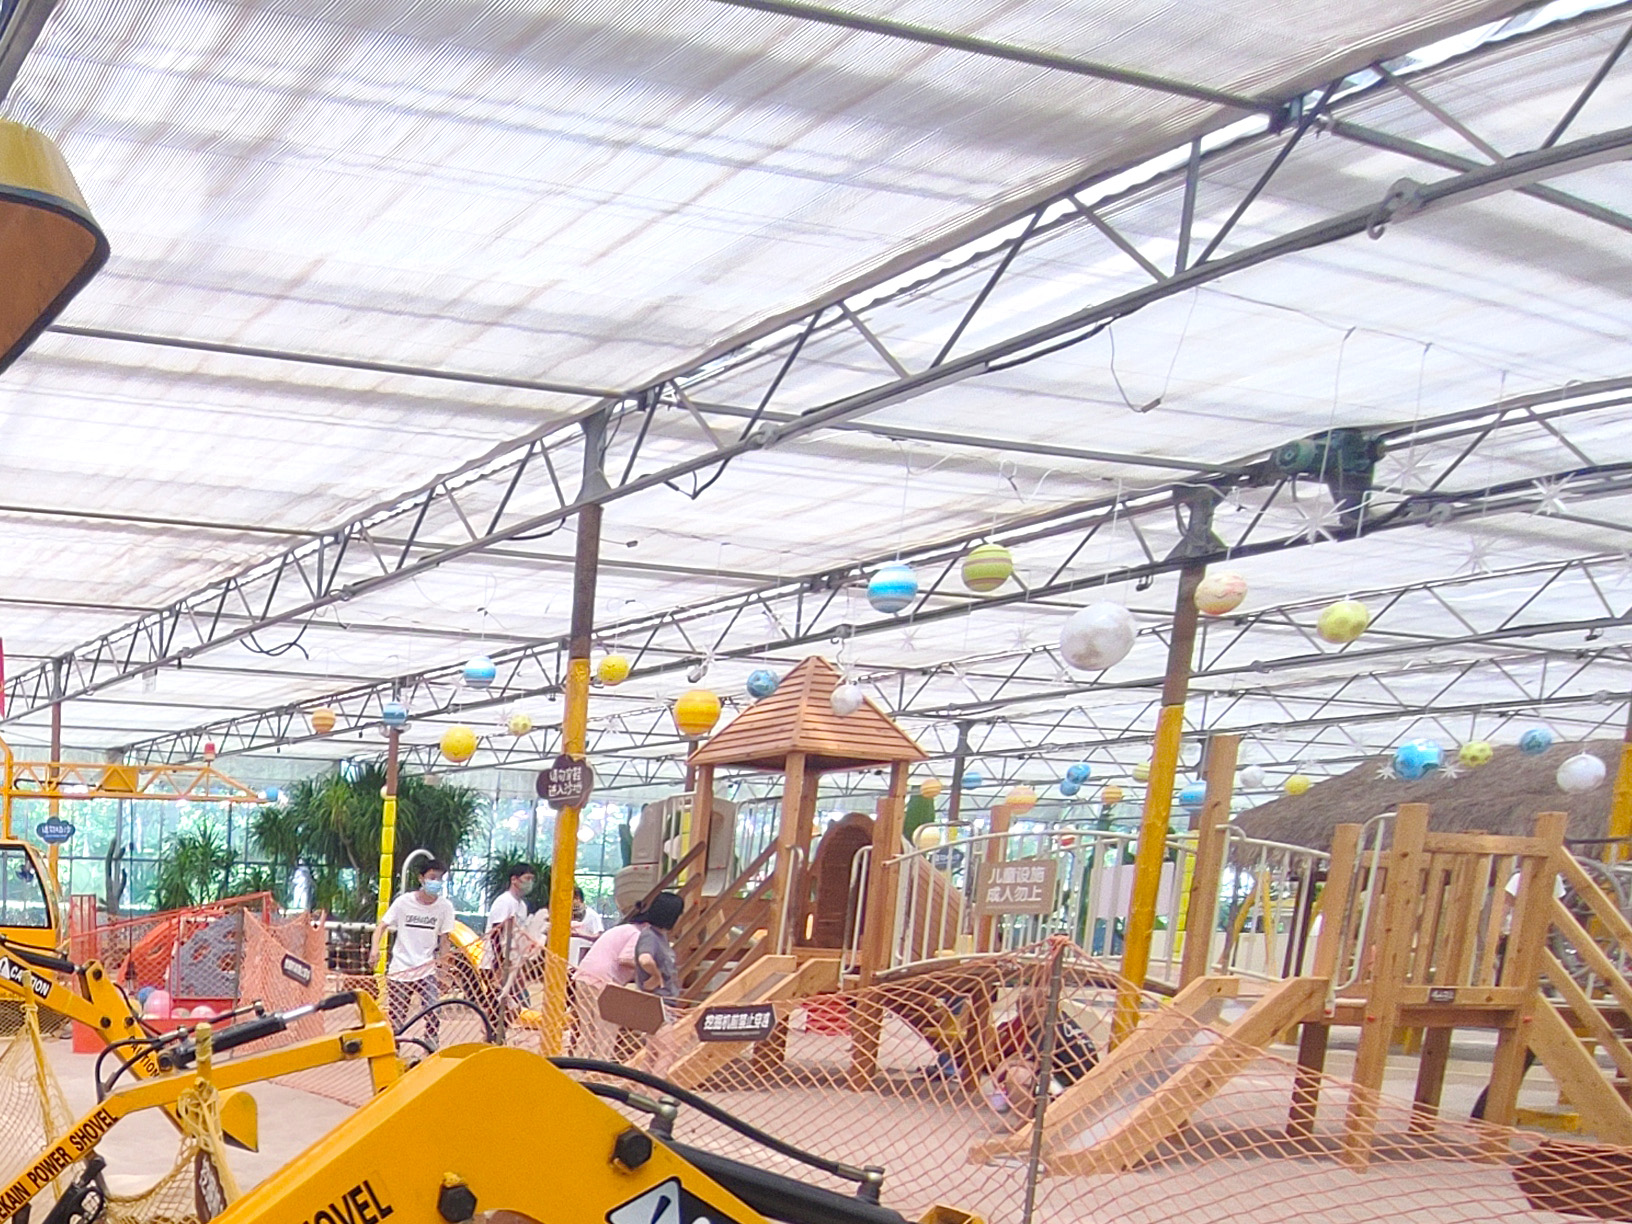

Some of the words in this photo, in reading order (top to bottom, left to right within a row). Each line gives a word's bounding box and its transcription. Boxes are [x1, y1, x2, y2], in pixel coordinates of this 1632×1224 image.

[987, 866, 1045, 884] 儿童设施
[986, 885, 1042, 903] 成人勿上
[26, 1146, 73, 1189] POWER
[69, 1108, 118, 1152] SHOVEL
